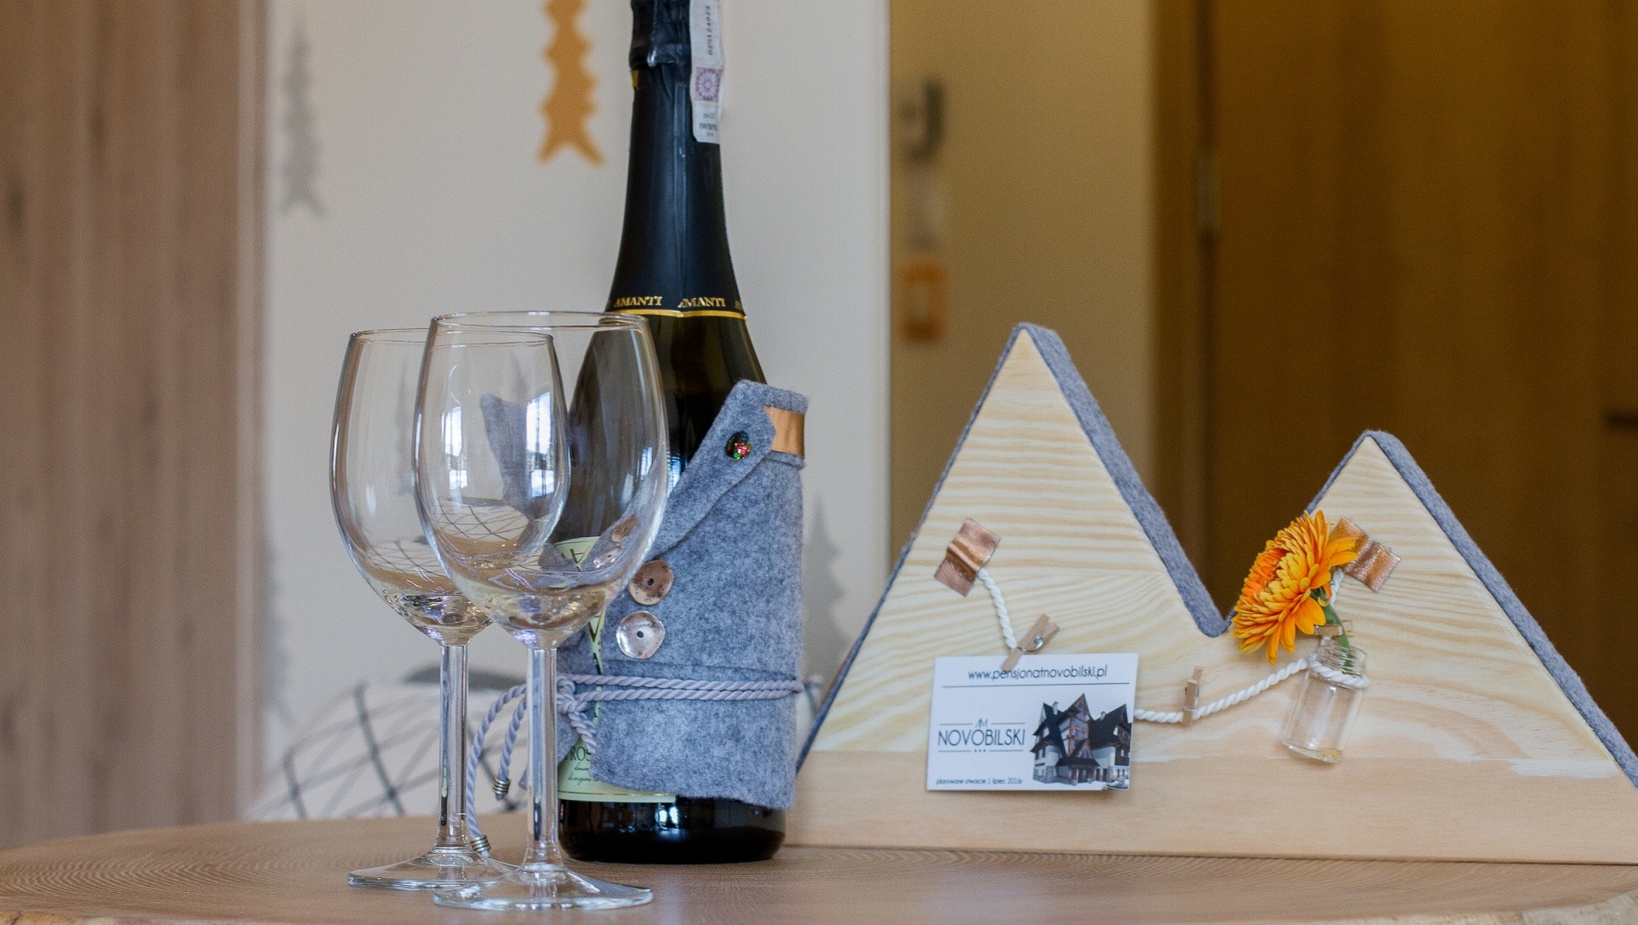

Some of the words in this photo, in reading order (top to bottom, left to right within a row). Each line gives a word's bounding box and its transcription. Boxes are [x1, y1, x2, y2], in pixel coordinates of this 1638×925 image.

[614, 296, 662, 307] AMANTI
[968, 664, 1108, 680] www.pensjonatnovobilski.pl
[938, 729, 1025, 746] NOVOBILSKI
